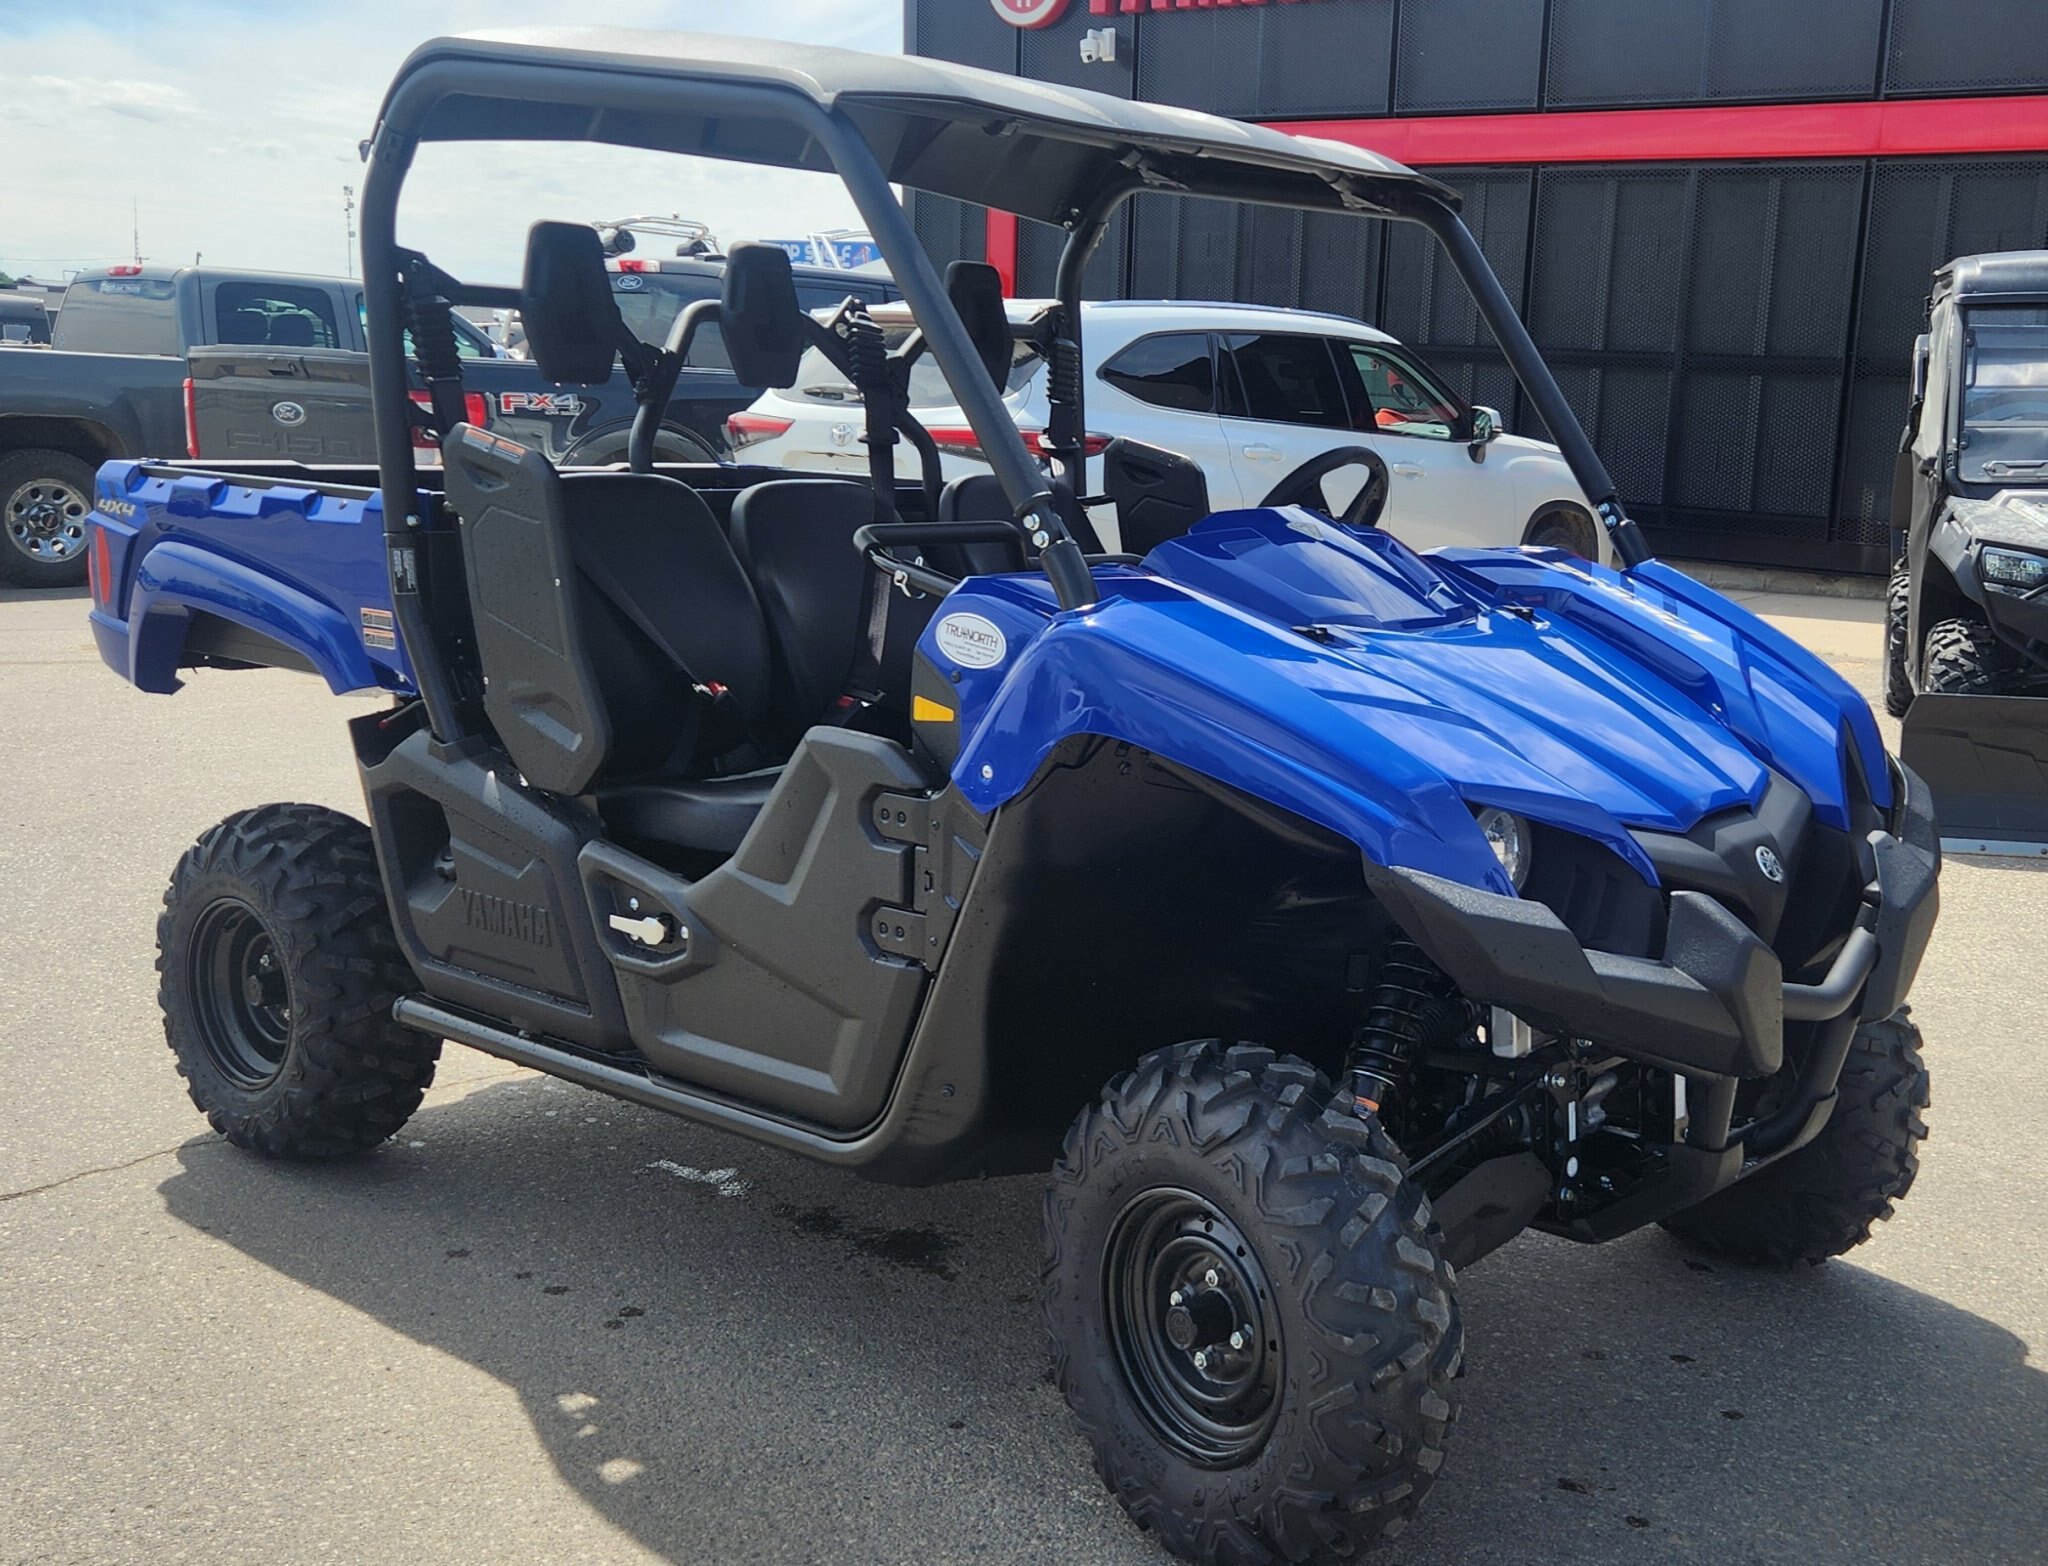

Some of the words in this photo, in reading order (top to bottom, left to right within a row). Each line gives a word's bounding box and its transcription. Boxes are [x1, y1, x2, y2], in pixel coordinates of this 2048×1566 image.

[805, 244, 852, 262] SLF
[500, 392, 579, 414] FX4
[458, 887, 553, 948] YAMAHA
